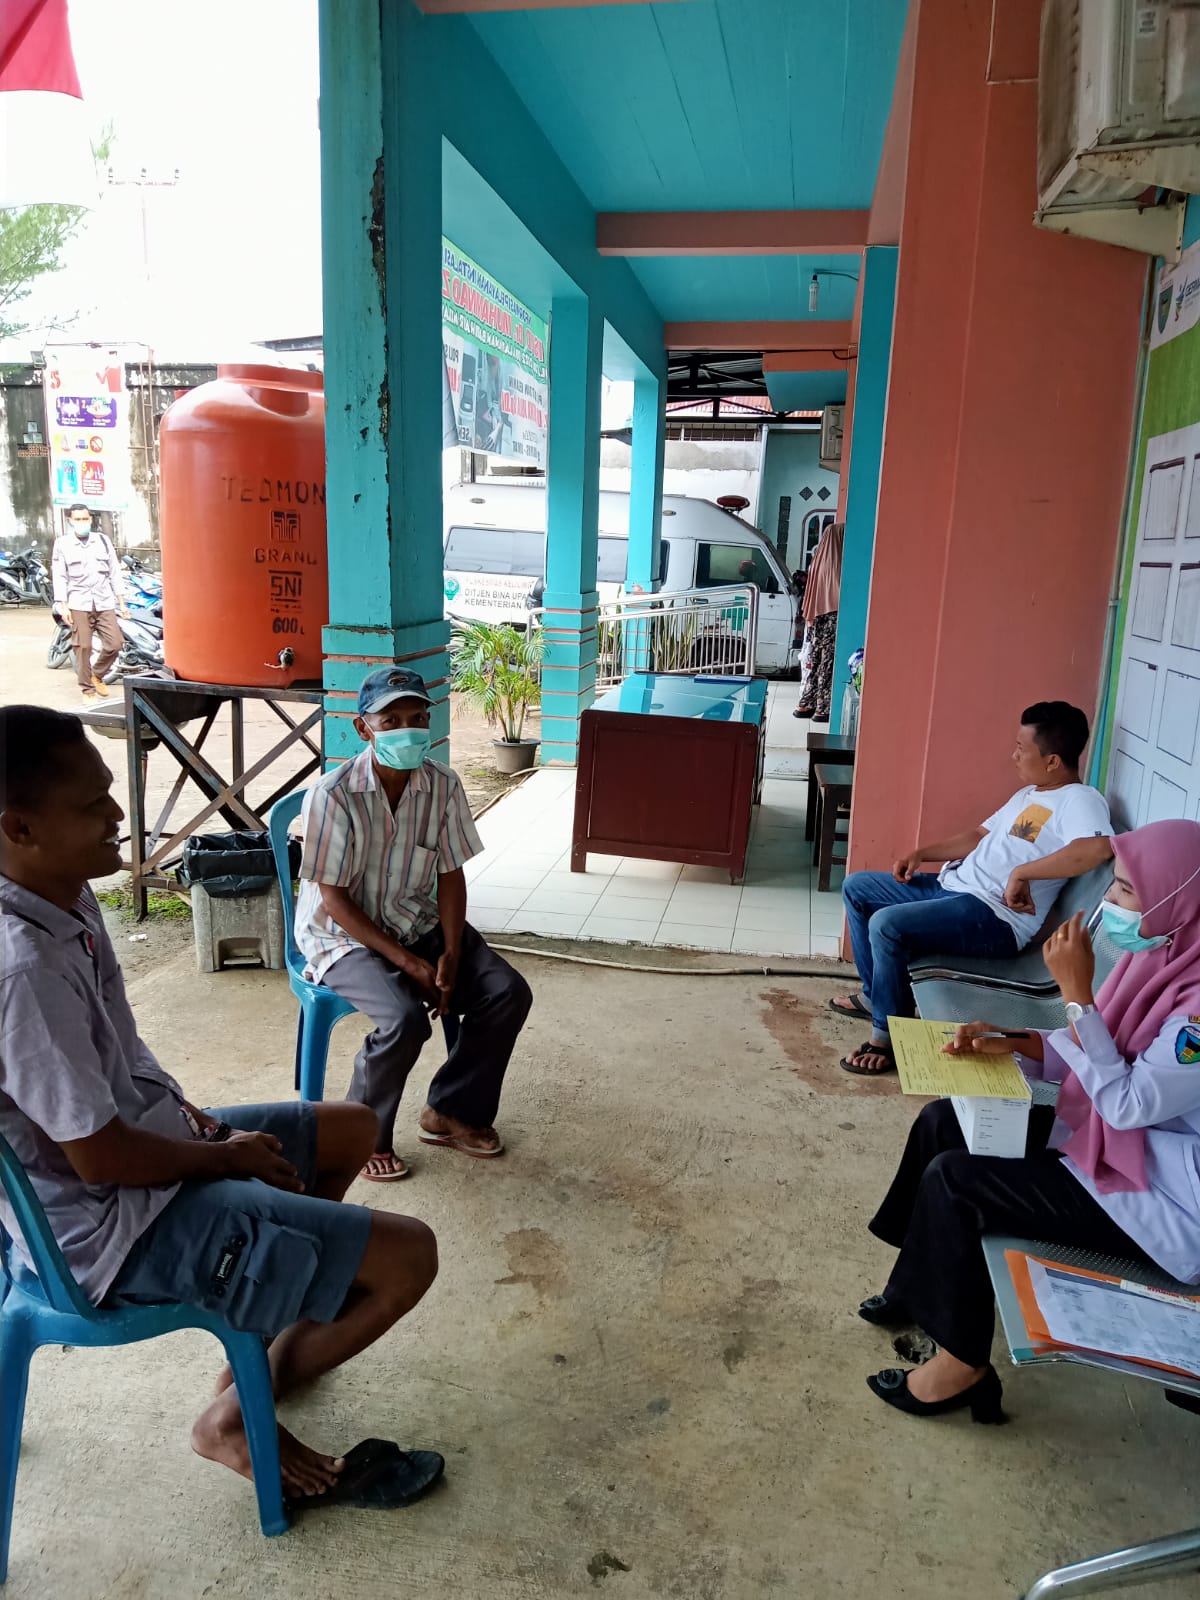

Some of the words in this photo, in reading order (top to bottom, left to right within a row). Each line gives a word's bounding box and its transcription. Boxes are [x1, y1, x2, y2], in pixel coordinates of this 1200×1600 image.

[270, 576, 302, 597] SNI
[464, 588, 491, 598] DITJEN
[492, 591, 510, 600] BINA
[464, 598, 521, 609] KEMENTERIAN
